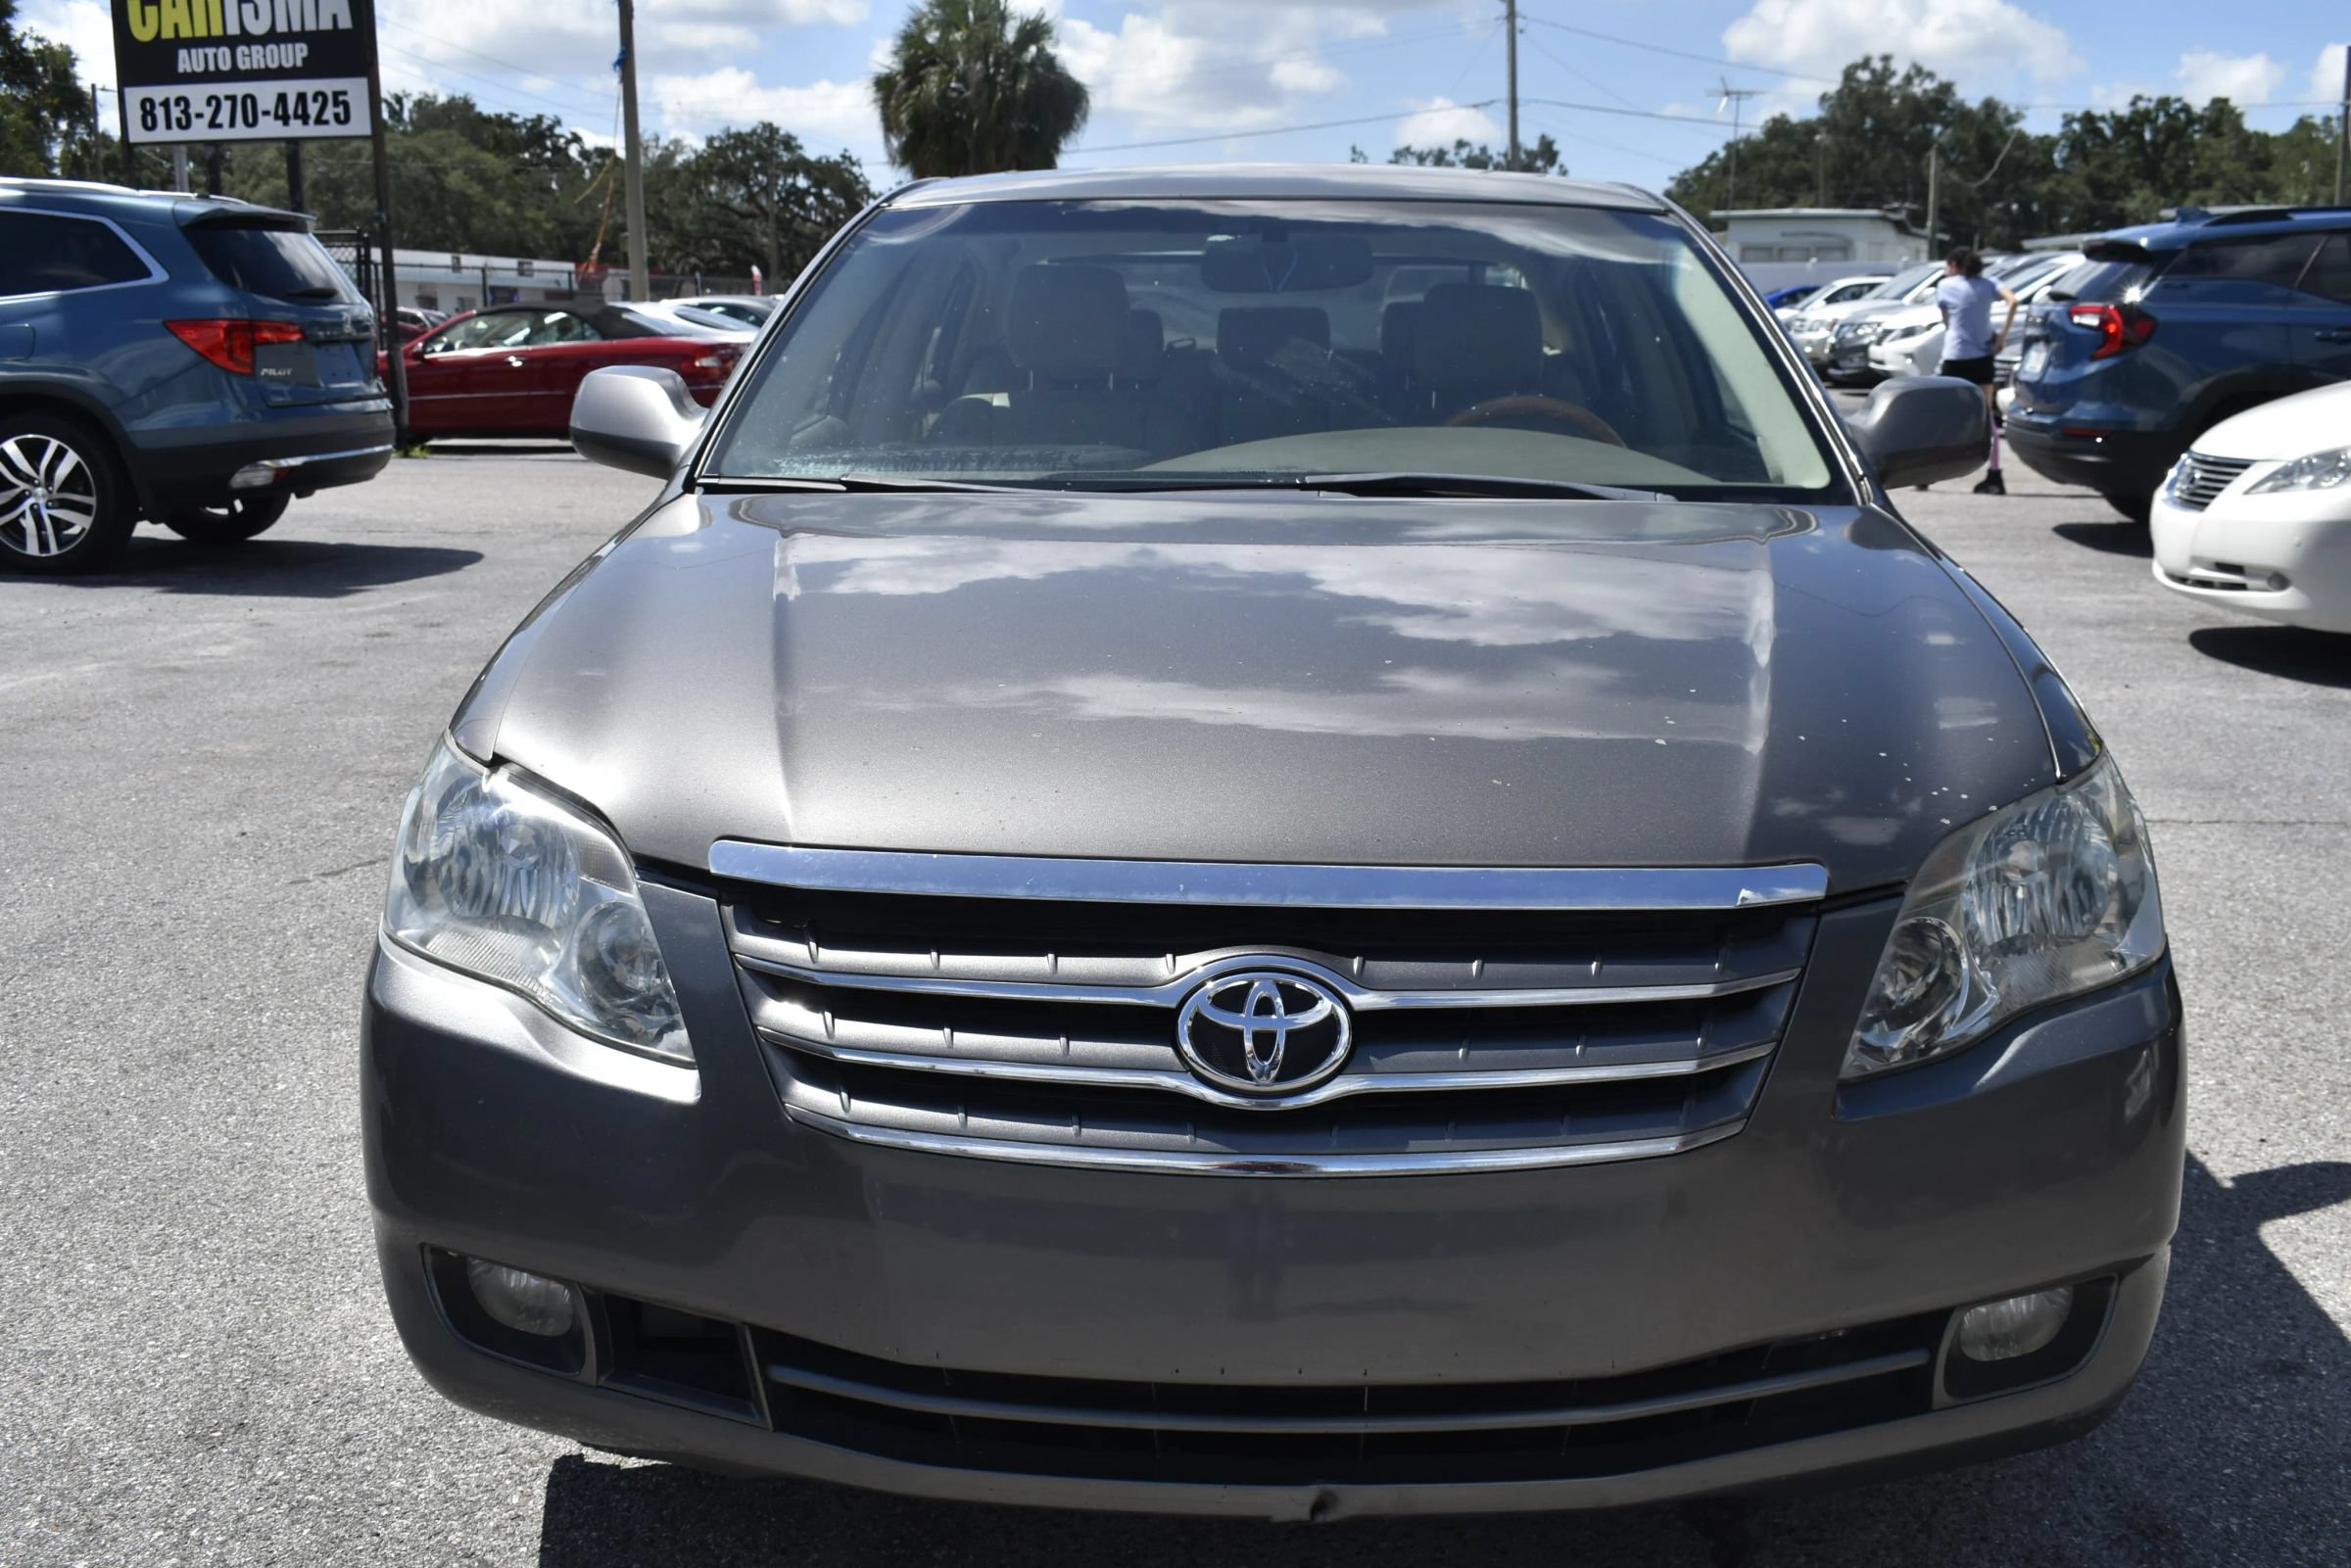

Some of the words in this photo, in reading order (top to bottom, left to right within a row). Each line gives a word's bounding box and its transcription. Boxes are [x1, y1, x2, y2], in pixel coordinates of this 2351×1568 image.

[177, 47, 231, 73] AUTO
[236, 43, 309, 71] GROUP
[139, 90, 352, 132] 813-270-4425
